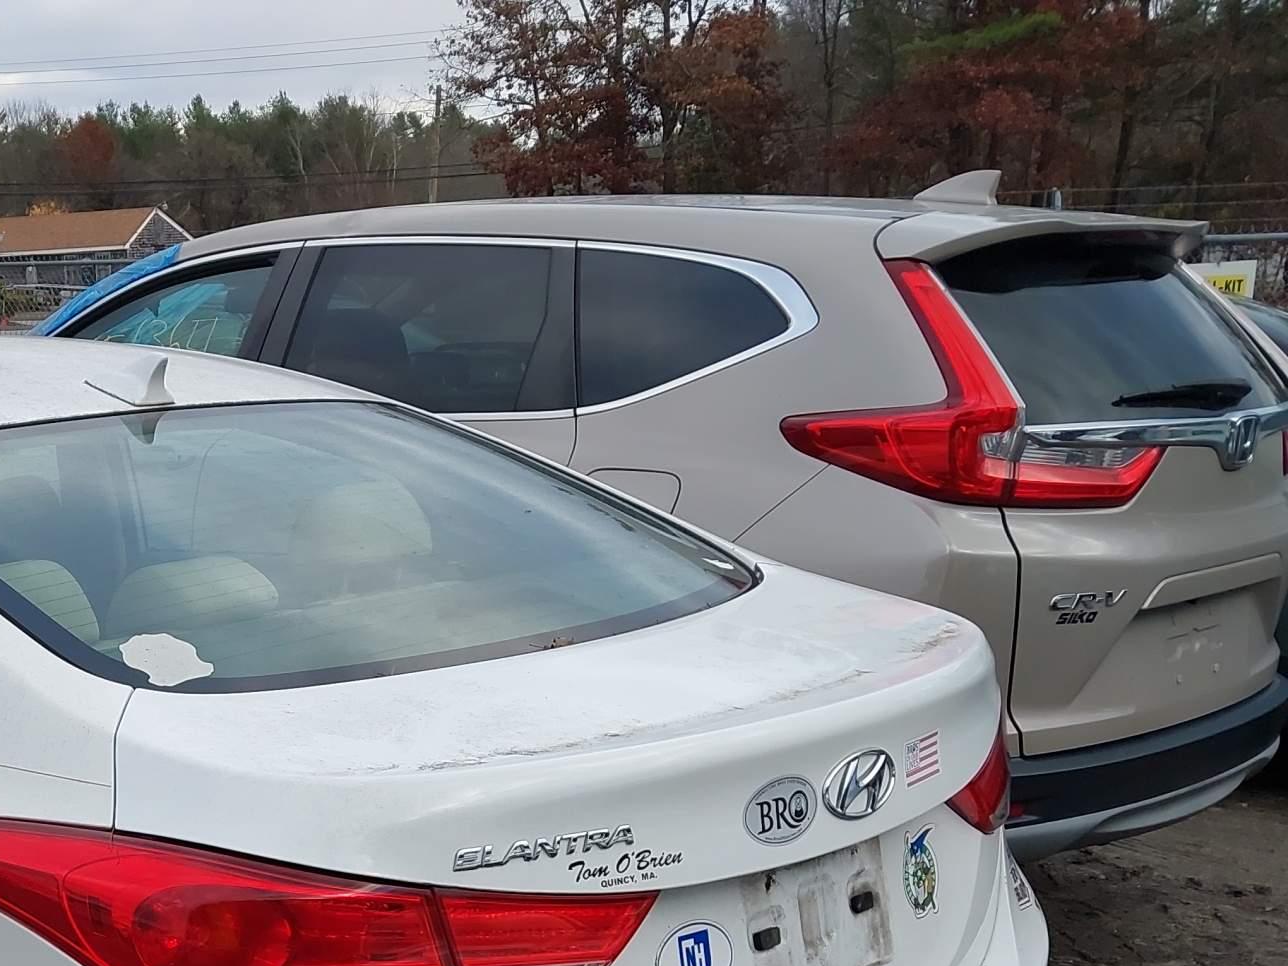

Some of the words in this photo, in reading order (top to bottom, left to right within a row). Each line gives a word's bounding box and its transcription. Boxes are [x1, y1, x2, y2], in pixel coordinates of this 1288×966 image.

[1050, 588, 1129, 610] CR-V
[755, 789, 809, 836] BRO
[453, 824, 634, 872] ELANTRA
[568, 860, 610, 883] Tom
[616, 849, 684, 873] O'Brien
[600, 876, 638, 889] QUINCY,
[641, 872, 658, 882] MA.
